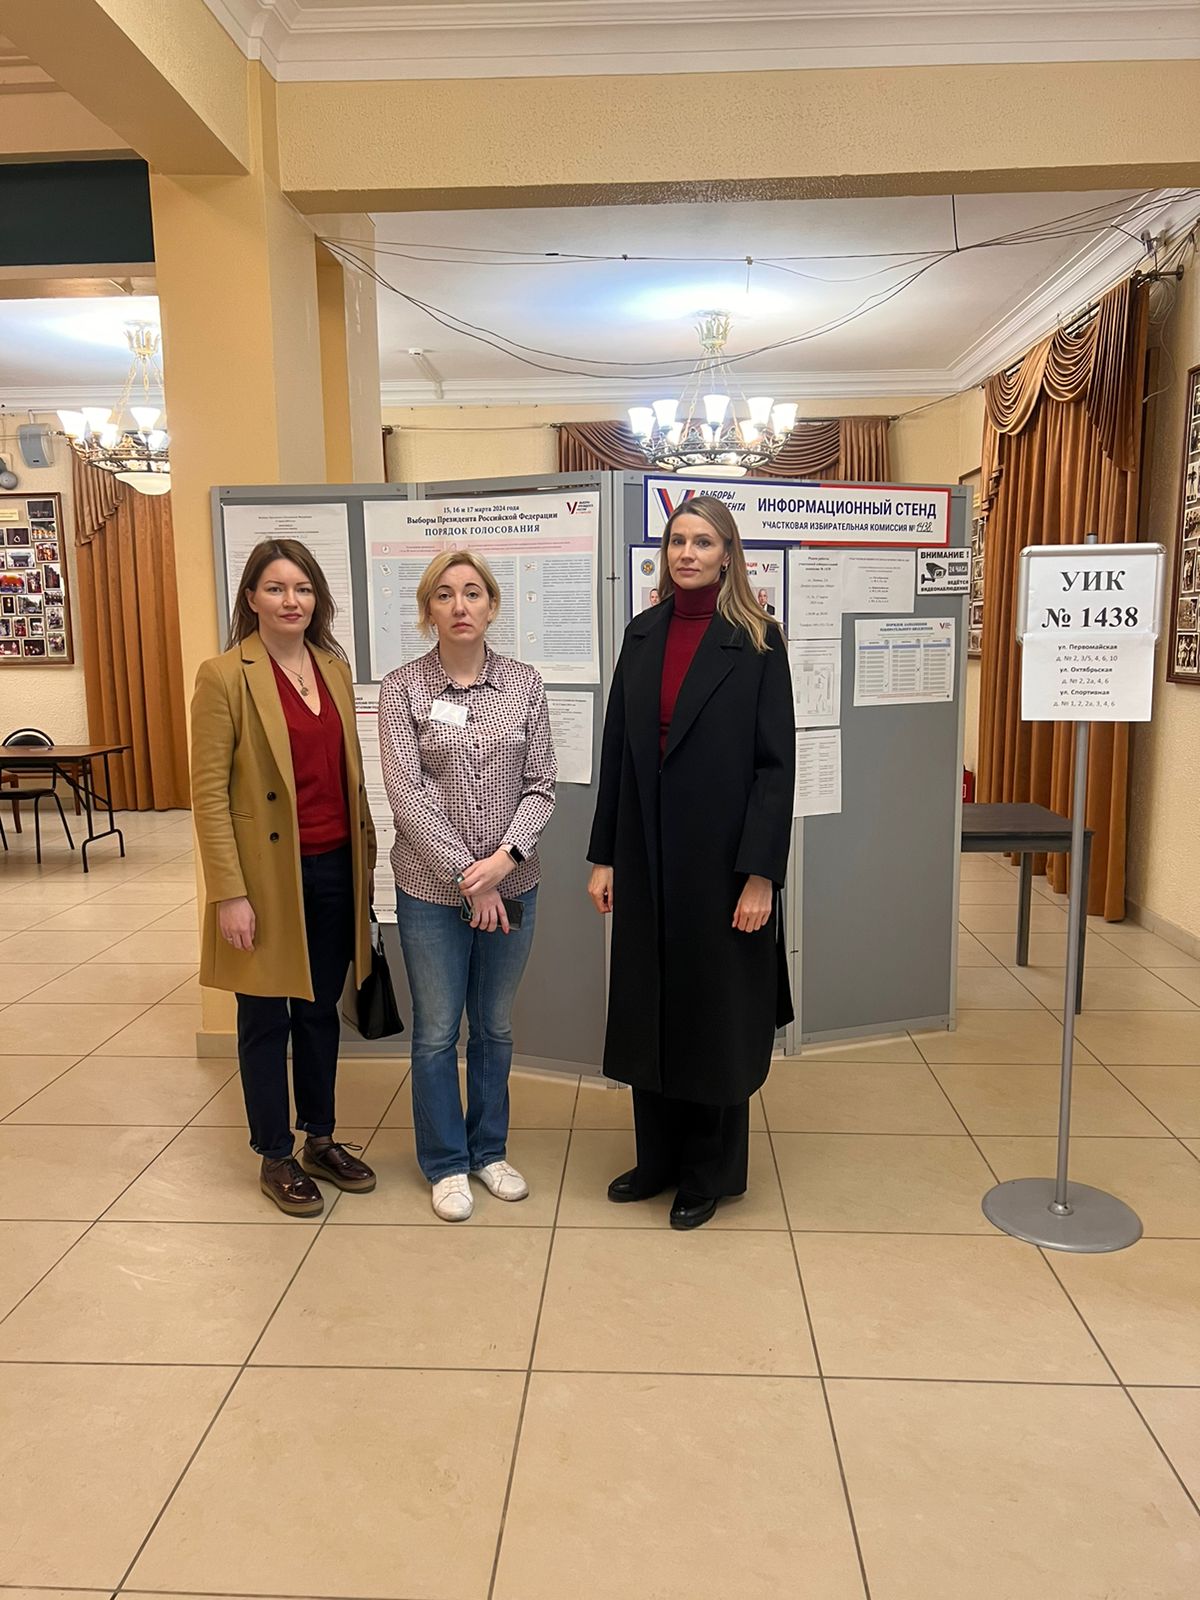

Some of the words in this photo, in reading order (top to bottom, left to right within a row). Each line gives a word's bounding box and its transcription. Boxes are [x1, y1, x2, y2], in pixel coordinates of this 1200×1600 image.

[758, 498, 892, 516] ИНФОРМАЦИОННЫЙ
[895, 502, 937, 519] СТЕНД
[406, 515, 436, 525] Выборы
[437, 515, 476, 525] Президента
[478, 513, 517, 522] Российской
[518, 511, 558, 521] Федерации
[762, 521, 808, 530] УЧАСТКОВАЯ
[809, 522, 868, 531] ИЗБИРАТЕЛЬНАЯ
[870, 523, 907, 532] КОМИССИЯ
[425, 526, 468, 537] ПОРЯДОК
[470, 524, 540, 535] ГОЛОСОВАНИЯ
[1060, 570, 1126, 592] УИК
[1041, 608, 1072, 628] №
[1080, 606, 1139, 628] 1438
